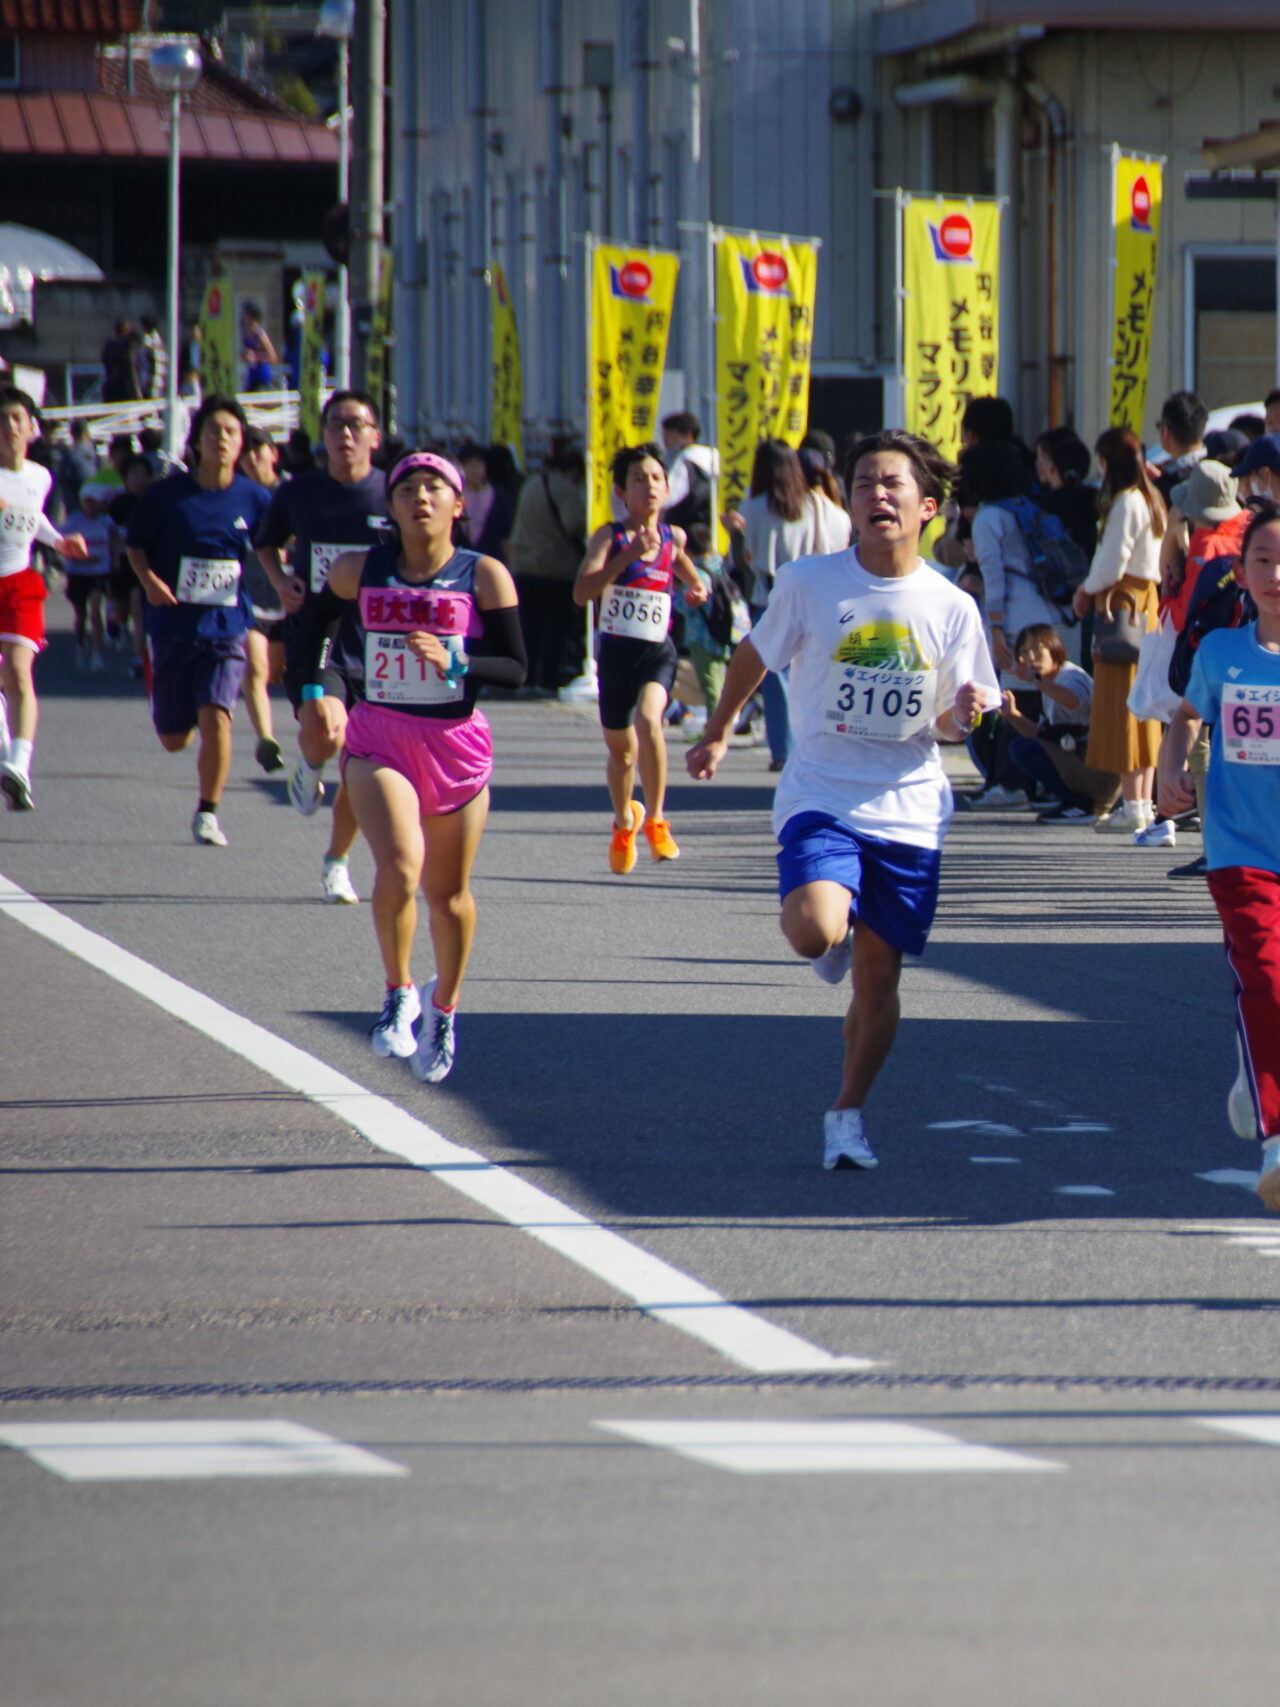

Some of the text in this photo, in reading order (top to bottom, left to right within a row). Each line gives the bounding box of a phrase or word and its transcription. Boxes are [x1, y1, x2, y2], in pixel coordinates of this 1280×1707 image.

[367, 596, 456, 628] 日大東北
[608, 599, 662, 624] 3056
[375, 652, 446, 681] 211
[856, 670, 925, 686] エイジェック
[837, 682, 923, 717] 3105
